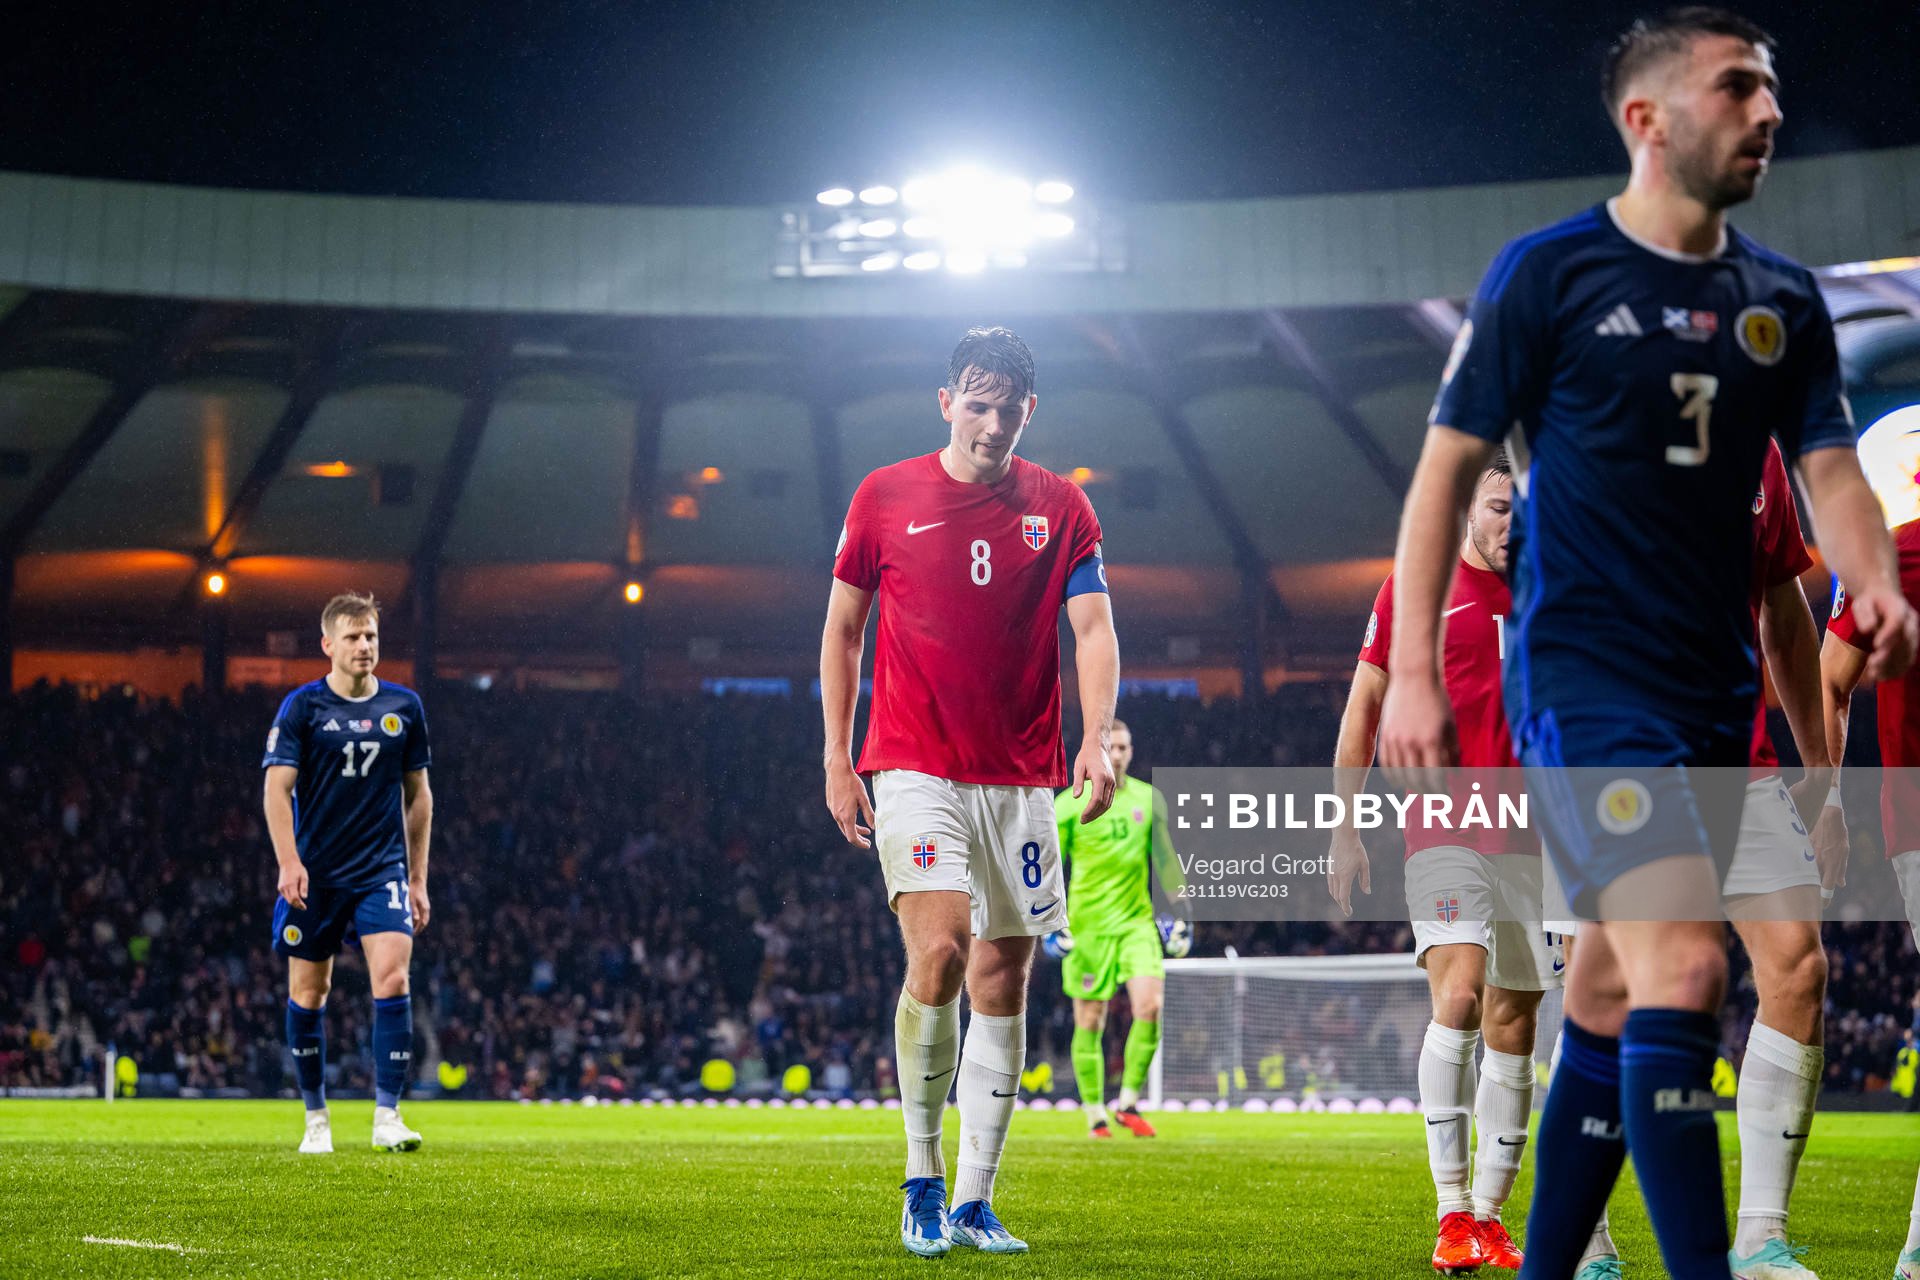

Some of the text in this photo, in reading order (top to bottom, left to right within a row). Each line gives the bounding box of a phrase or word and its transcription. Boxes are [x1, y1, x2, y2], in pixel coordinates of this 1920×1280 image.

[1665, 372, 1719, 467] 3
[970, 539, 992, 586] 8
[342, 741, 381, 777] 17
[1111, 817, 1129, 840] 13
[1021, 841, 1042, 888] 8
